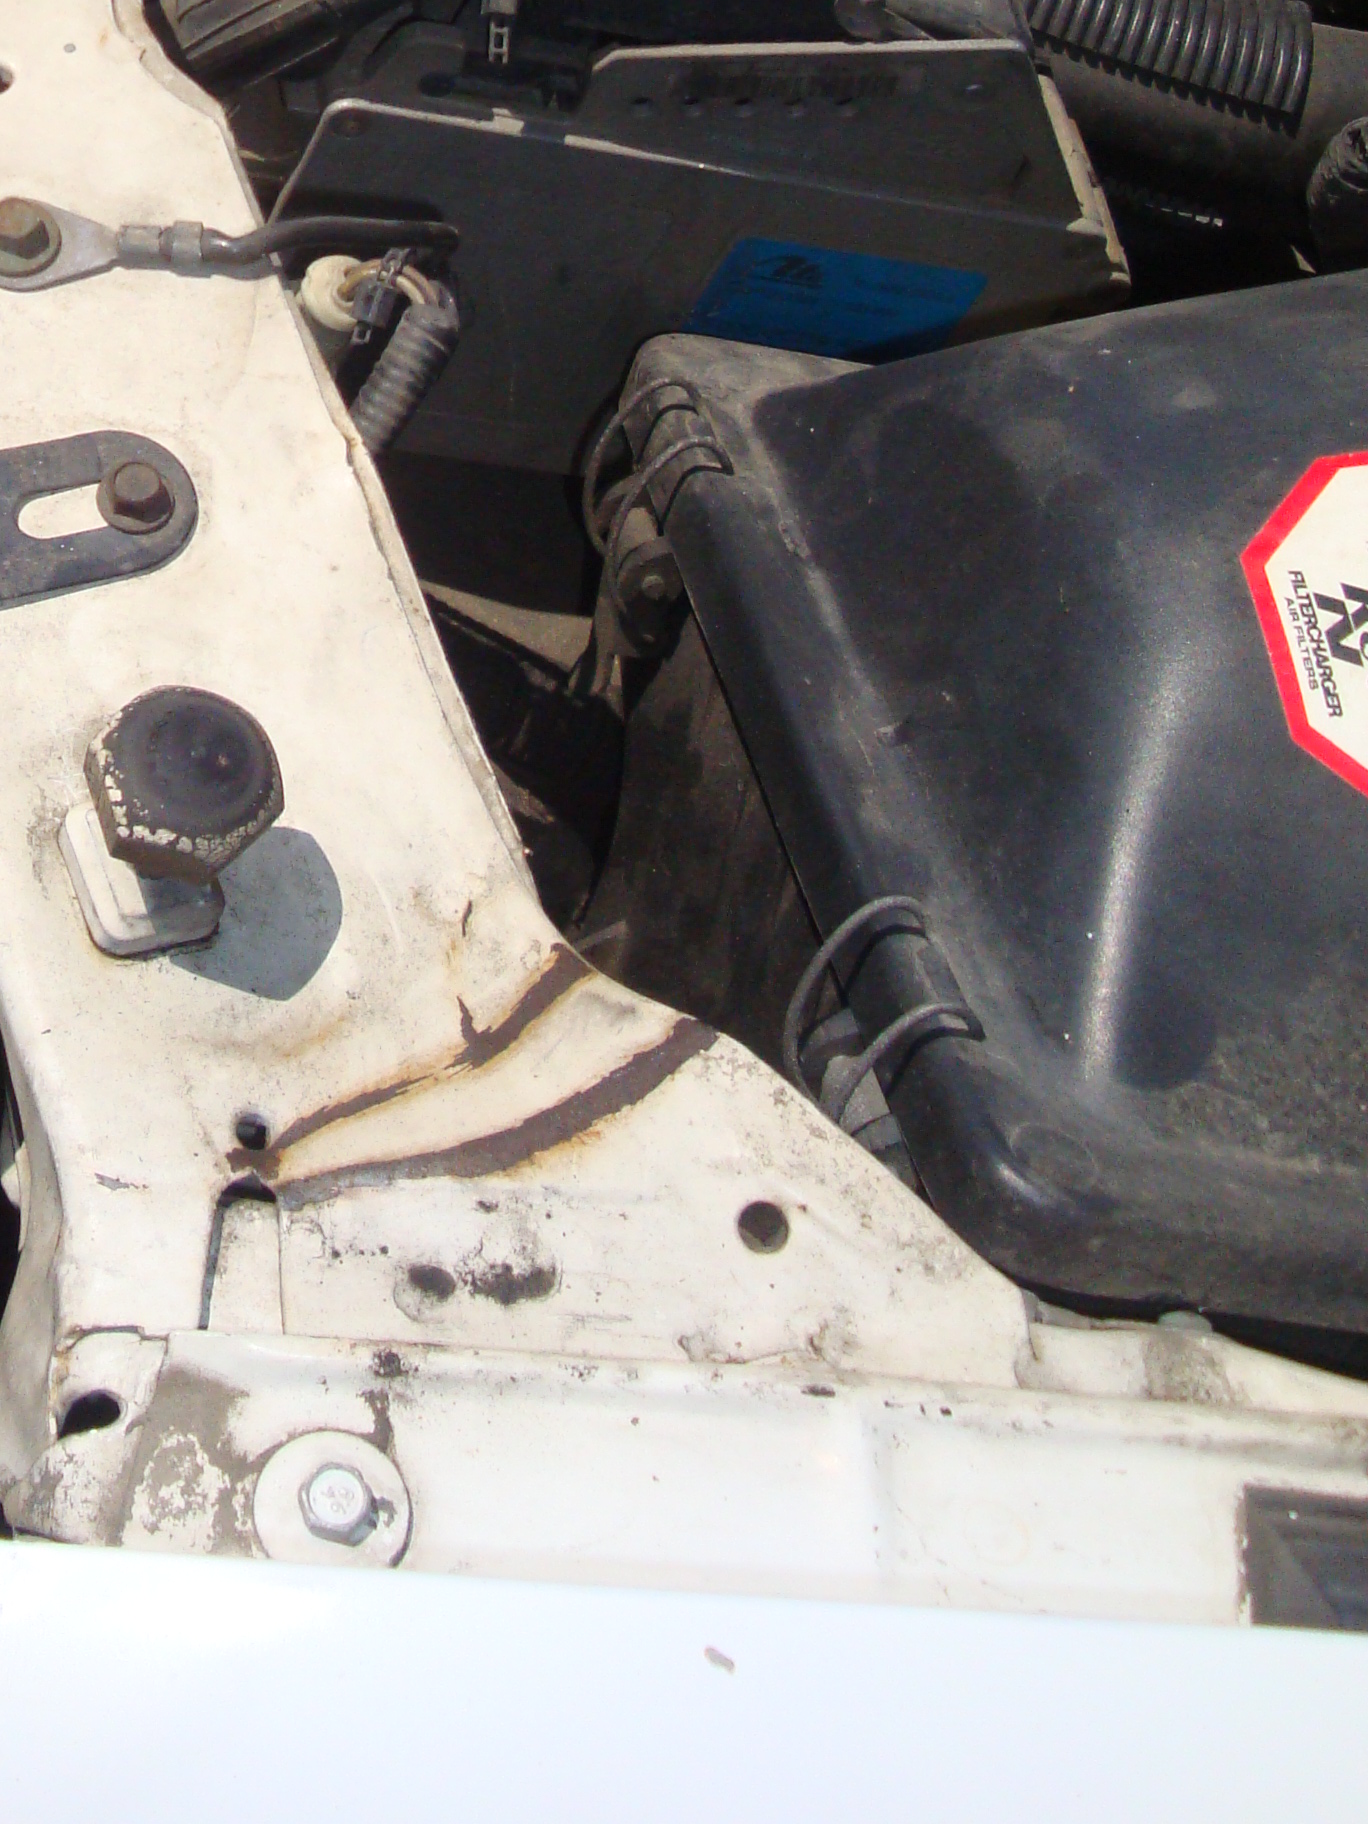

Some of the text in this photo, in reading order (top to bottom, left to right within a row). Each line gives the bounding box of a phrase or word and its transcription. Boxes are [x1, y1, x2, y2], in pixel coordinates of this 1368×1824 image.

[1283, 595, 1319, 691] AIR FILTERS
[1287, 569, 1344, 718] FILTERCHARGER
